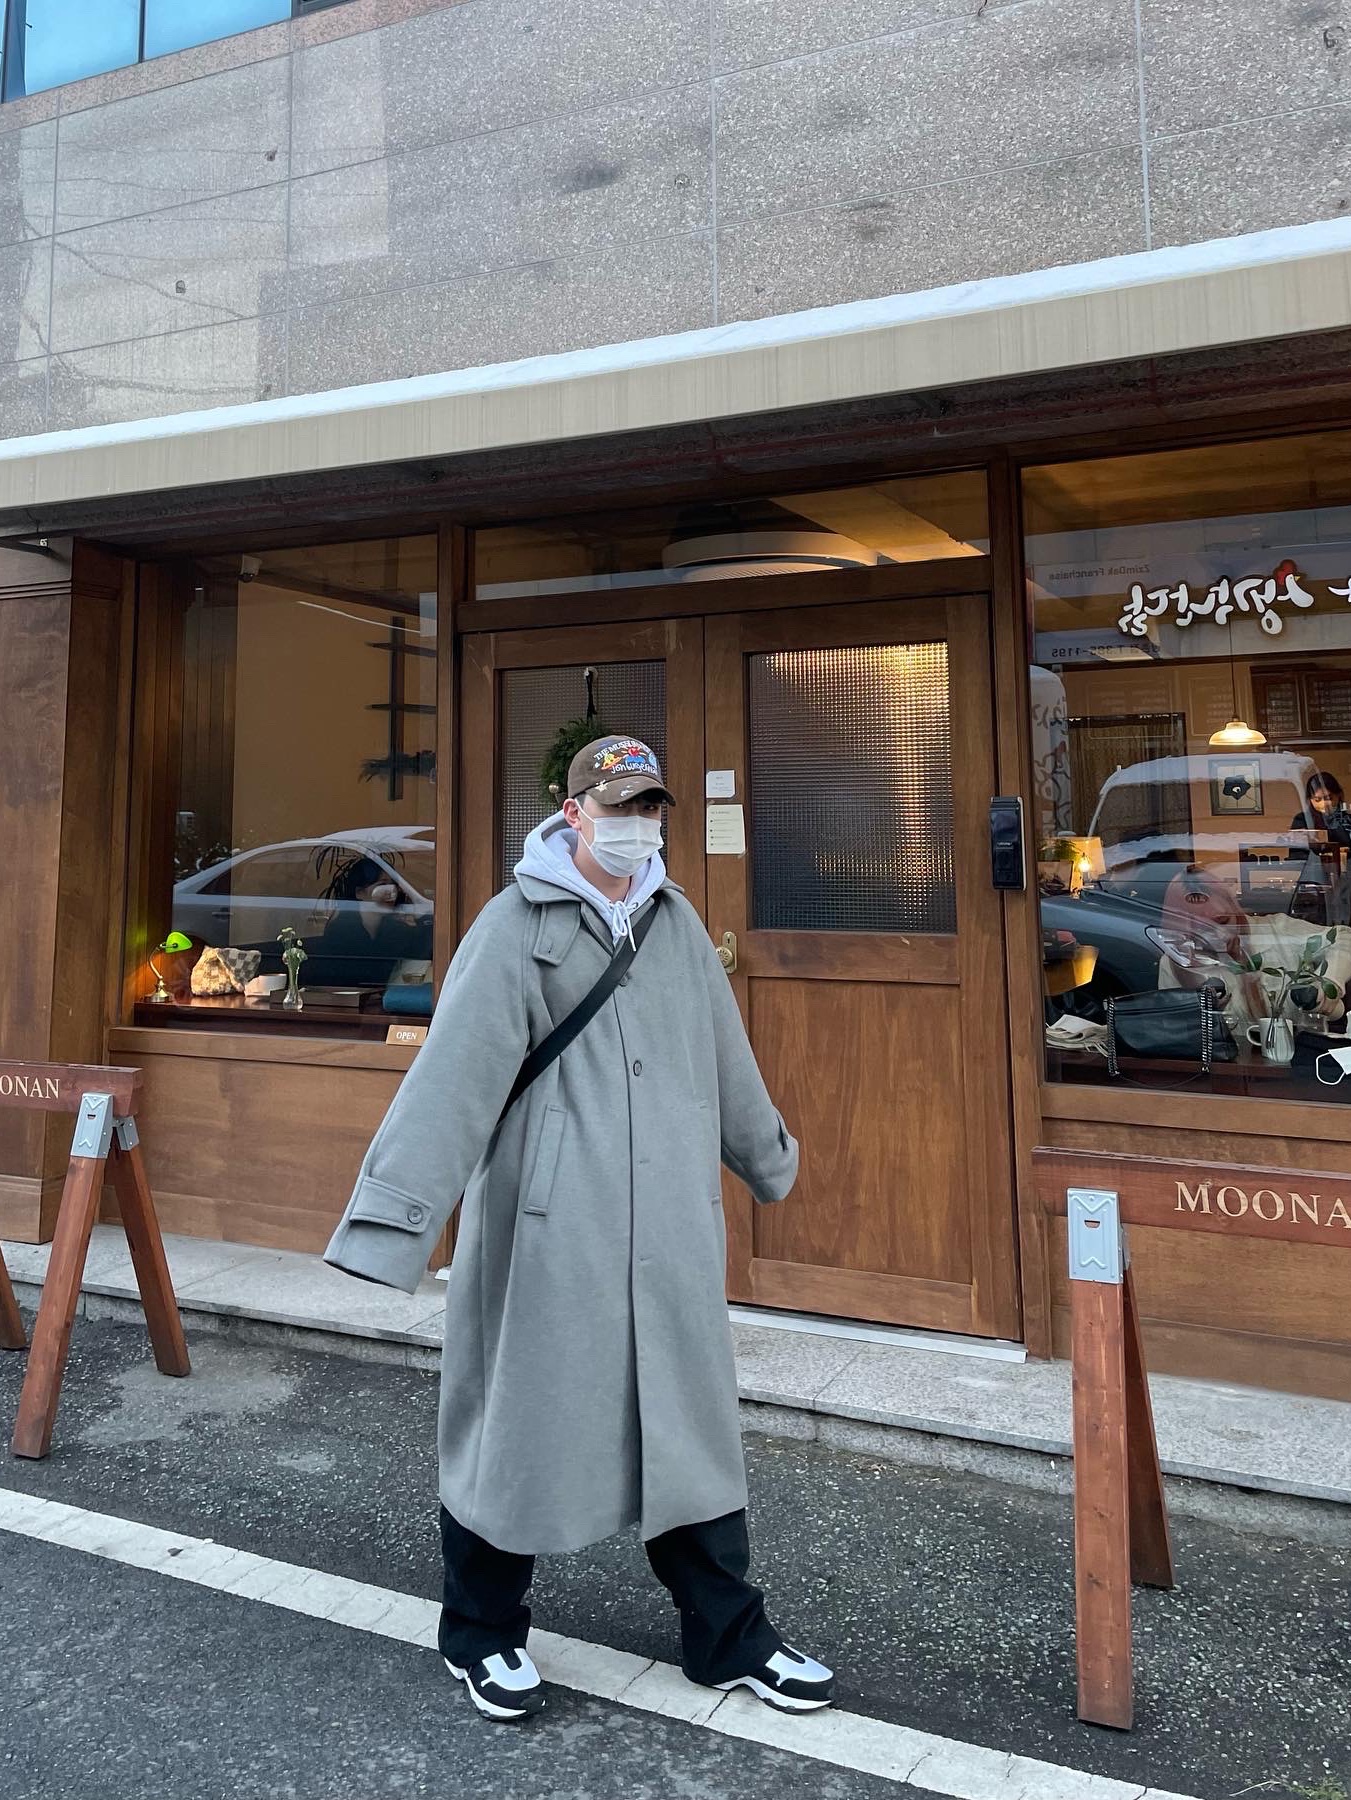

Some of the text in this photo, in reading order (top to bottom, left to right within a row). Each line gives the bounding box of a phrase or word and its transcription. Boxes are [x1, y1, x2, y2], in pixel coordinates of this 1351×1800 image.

[593, 747, 610, 761] THE
[395, 1031, 418, 1041] OPEN
[0, 1074, 60, 1099] ONAN
[1174, 1181, 1351, 1229] MOONA
